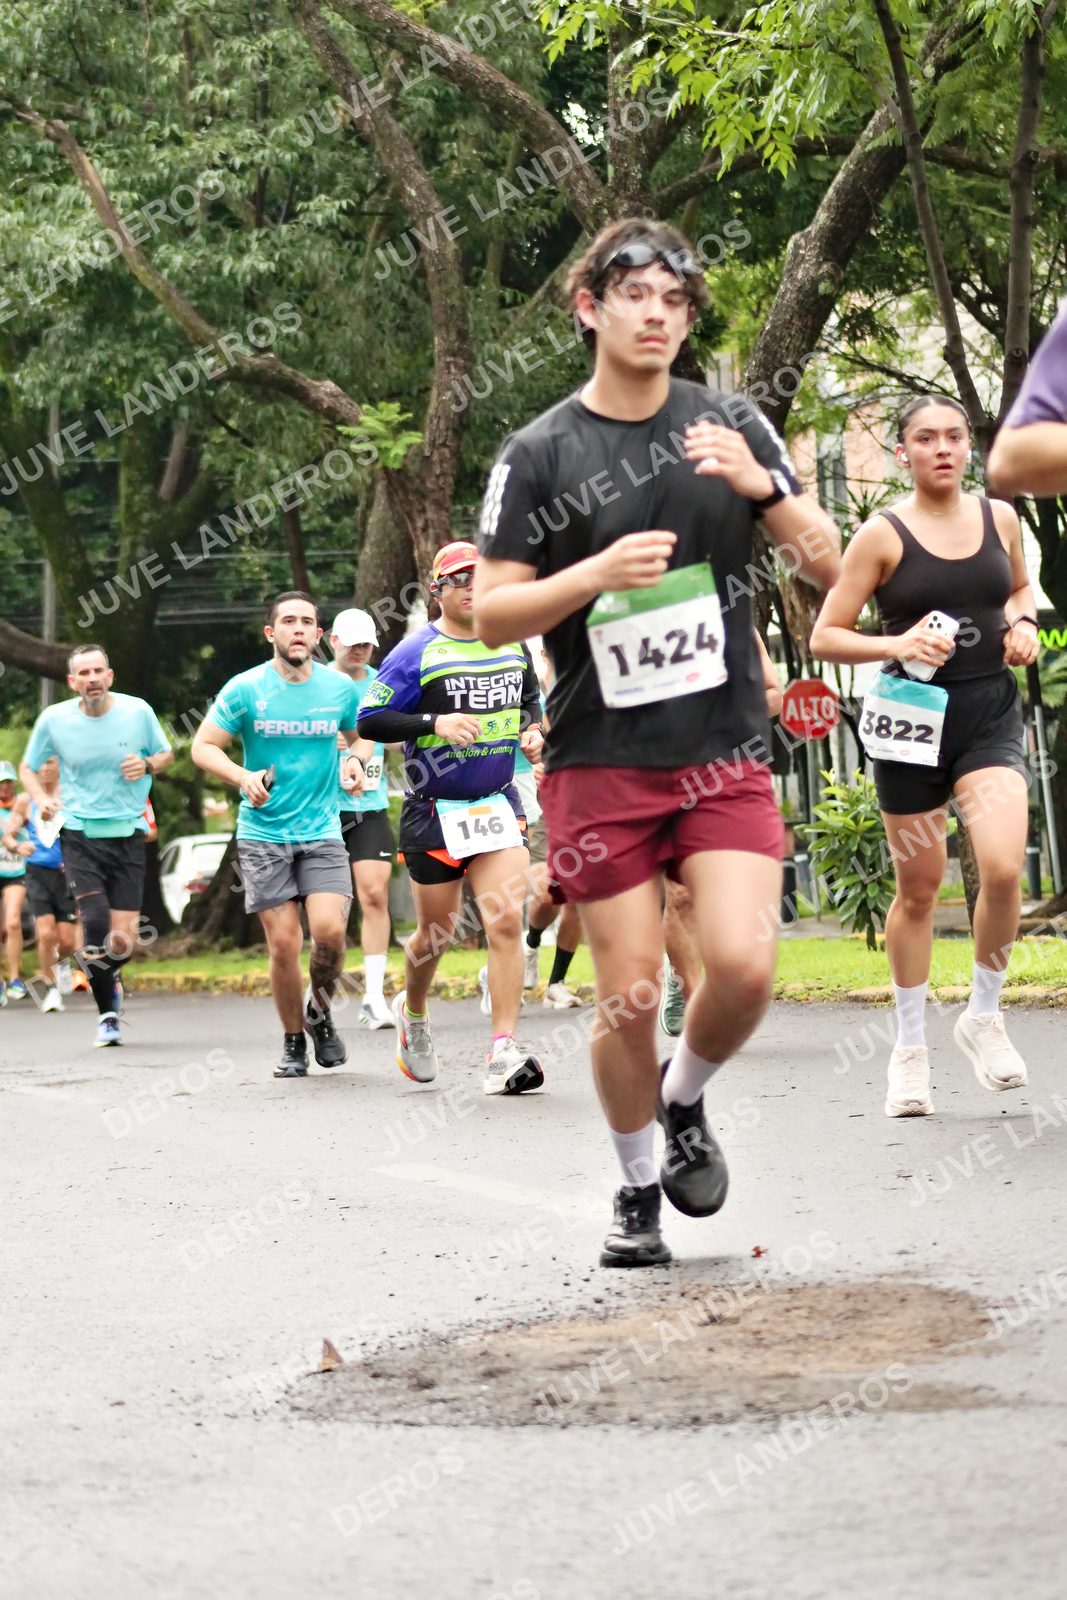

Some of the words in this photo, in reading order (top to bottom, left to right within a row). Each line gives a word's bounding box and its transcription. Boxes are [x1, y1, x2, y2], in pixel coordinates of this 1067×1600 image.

[607, 622, 719, 677] 1424
[444, 671, 524, 691] INTEGRA
[446, 684, 523, 710] TEAM
[785, 696, 836, 722] ALTO
[253, 719, 338, 736] PERDURA
[862, 710, 935, 745] 3822
[456, 816, 505, 841] 146
